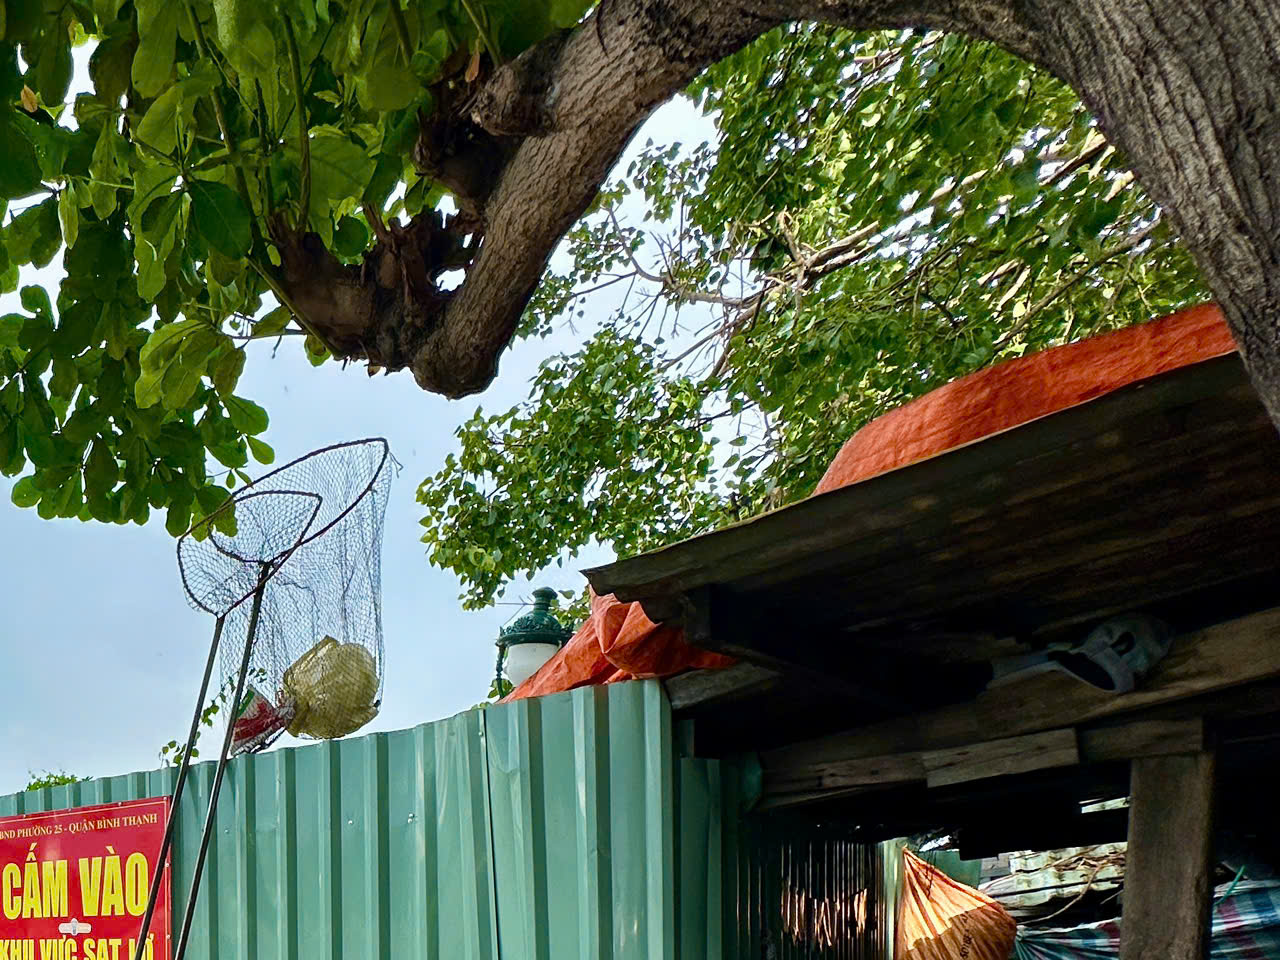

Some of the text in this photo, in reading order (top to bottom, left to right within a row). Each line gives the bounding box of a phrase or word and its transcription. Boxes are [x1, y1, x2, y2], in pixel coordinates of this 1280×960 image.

[17, 825, 53, 838] PHƯỜNG
[54, 824, 63, 834] 25
[69, 818, 95, 834] QUẬN
[97, 816, 121, 830] BÌNH
[122, 813, 158, 828] THẠNH
[2, 843, 149, 920] CẤM VÀO
